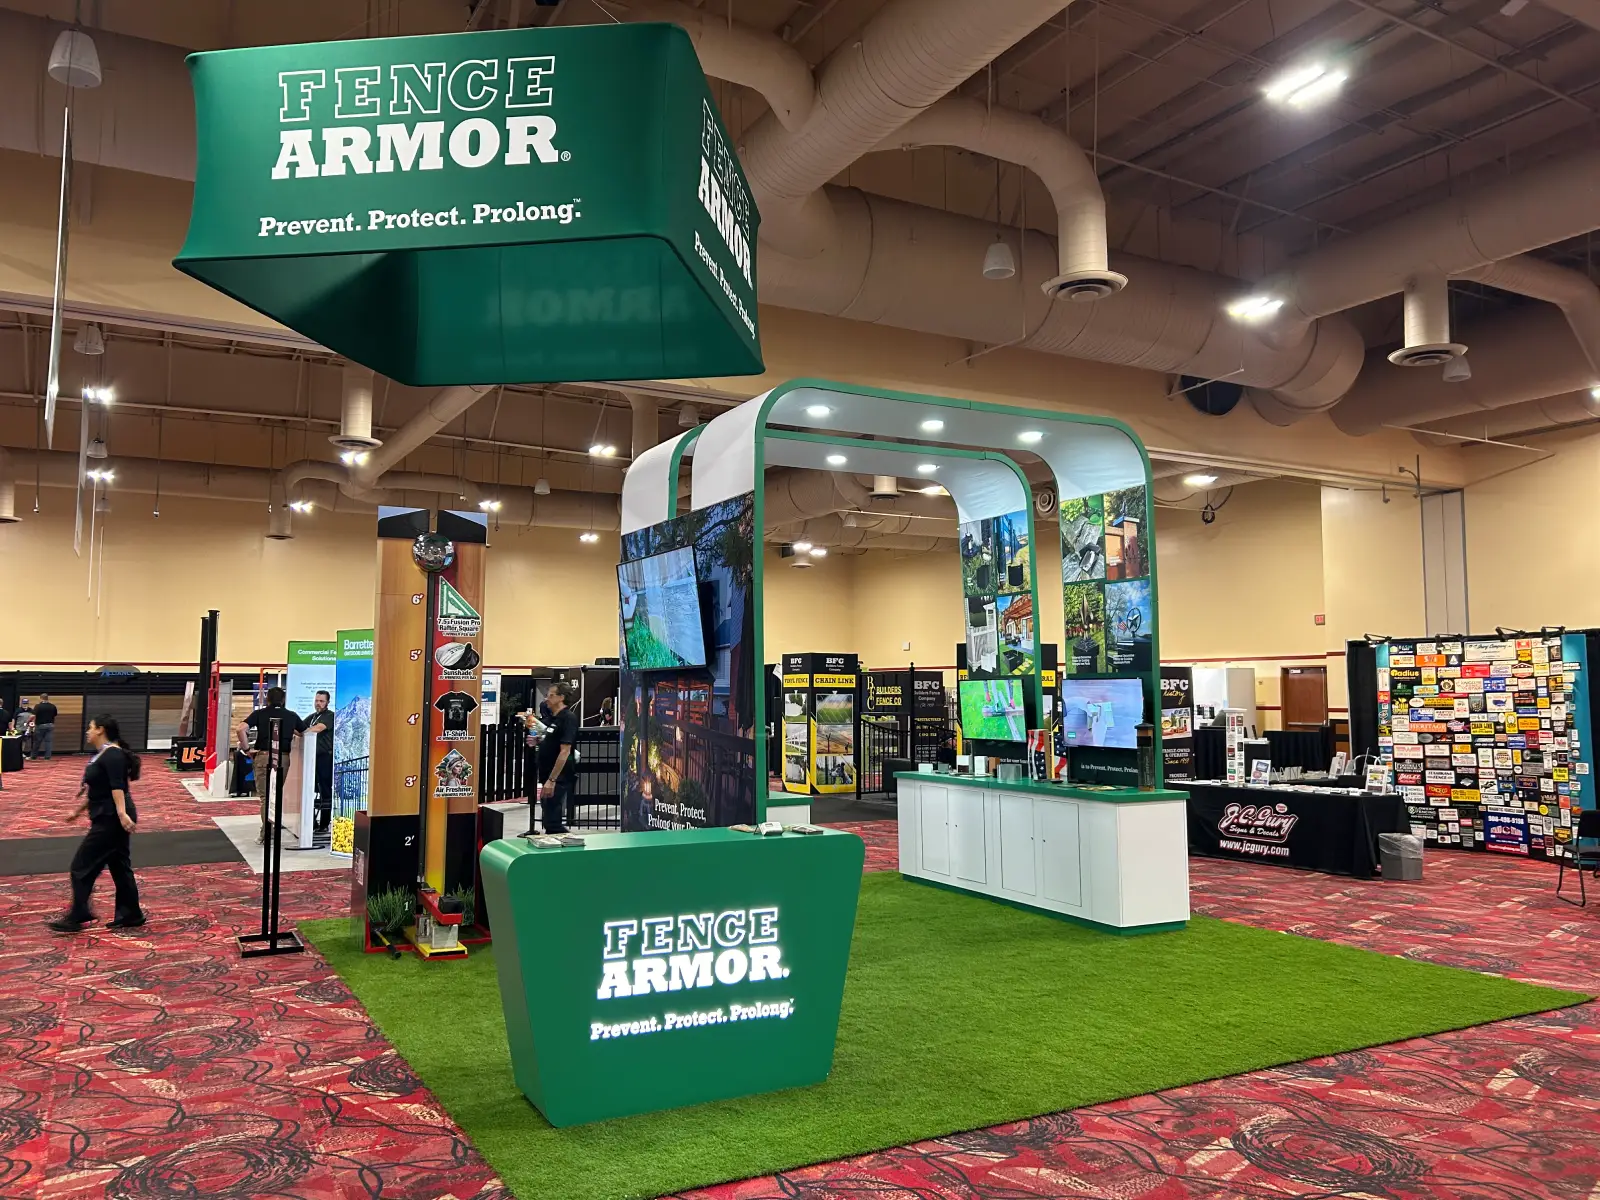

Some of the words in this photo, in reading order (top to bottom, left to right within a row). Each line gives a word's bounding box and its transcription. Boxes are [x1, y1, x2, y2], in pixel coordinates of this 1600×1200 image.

[278, 56, 555, 122] FENCE
[702, 97, 750, 241] FENCE
[258, 212, 361, 237] Prevent.
[368, 206, 466, 231] Protect.
[697, 155, 753, 291] ARMOR
[343, 639, 374, 650] Barrette
[876, 686, 902, 694] BUILDERS
[914, 680, 940, 690] BFC
[1160, 678, 1189, 691] BFC
[876, 696, 893, 705] FENCE
[893, 696, 902, 705] CO
[1163, 689, 1186, 705] history
[1090, 764, 1106, 772] Prevent,
[1107, 765, 1124, 773] Protect,
[655, 798, 679, 818] Prevent,
[680, 802, 706, 823] Protect,
[1229, 824, 1248, 834] Signs
[1249, 826, 1255, 834] &
[1257, 827, 1279, 837] Decals
[1219, 839, 1290, 857] www.jcgury.com
[602, 906, 778, 960] FENCE
[589, 1015, 662, 1041] Prevent.
[664, 1007, 727, 1031] Protect.
